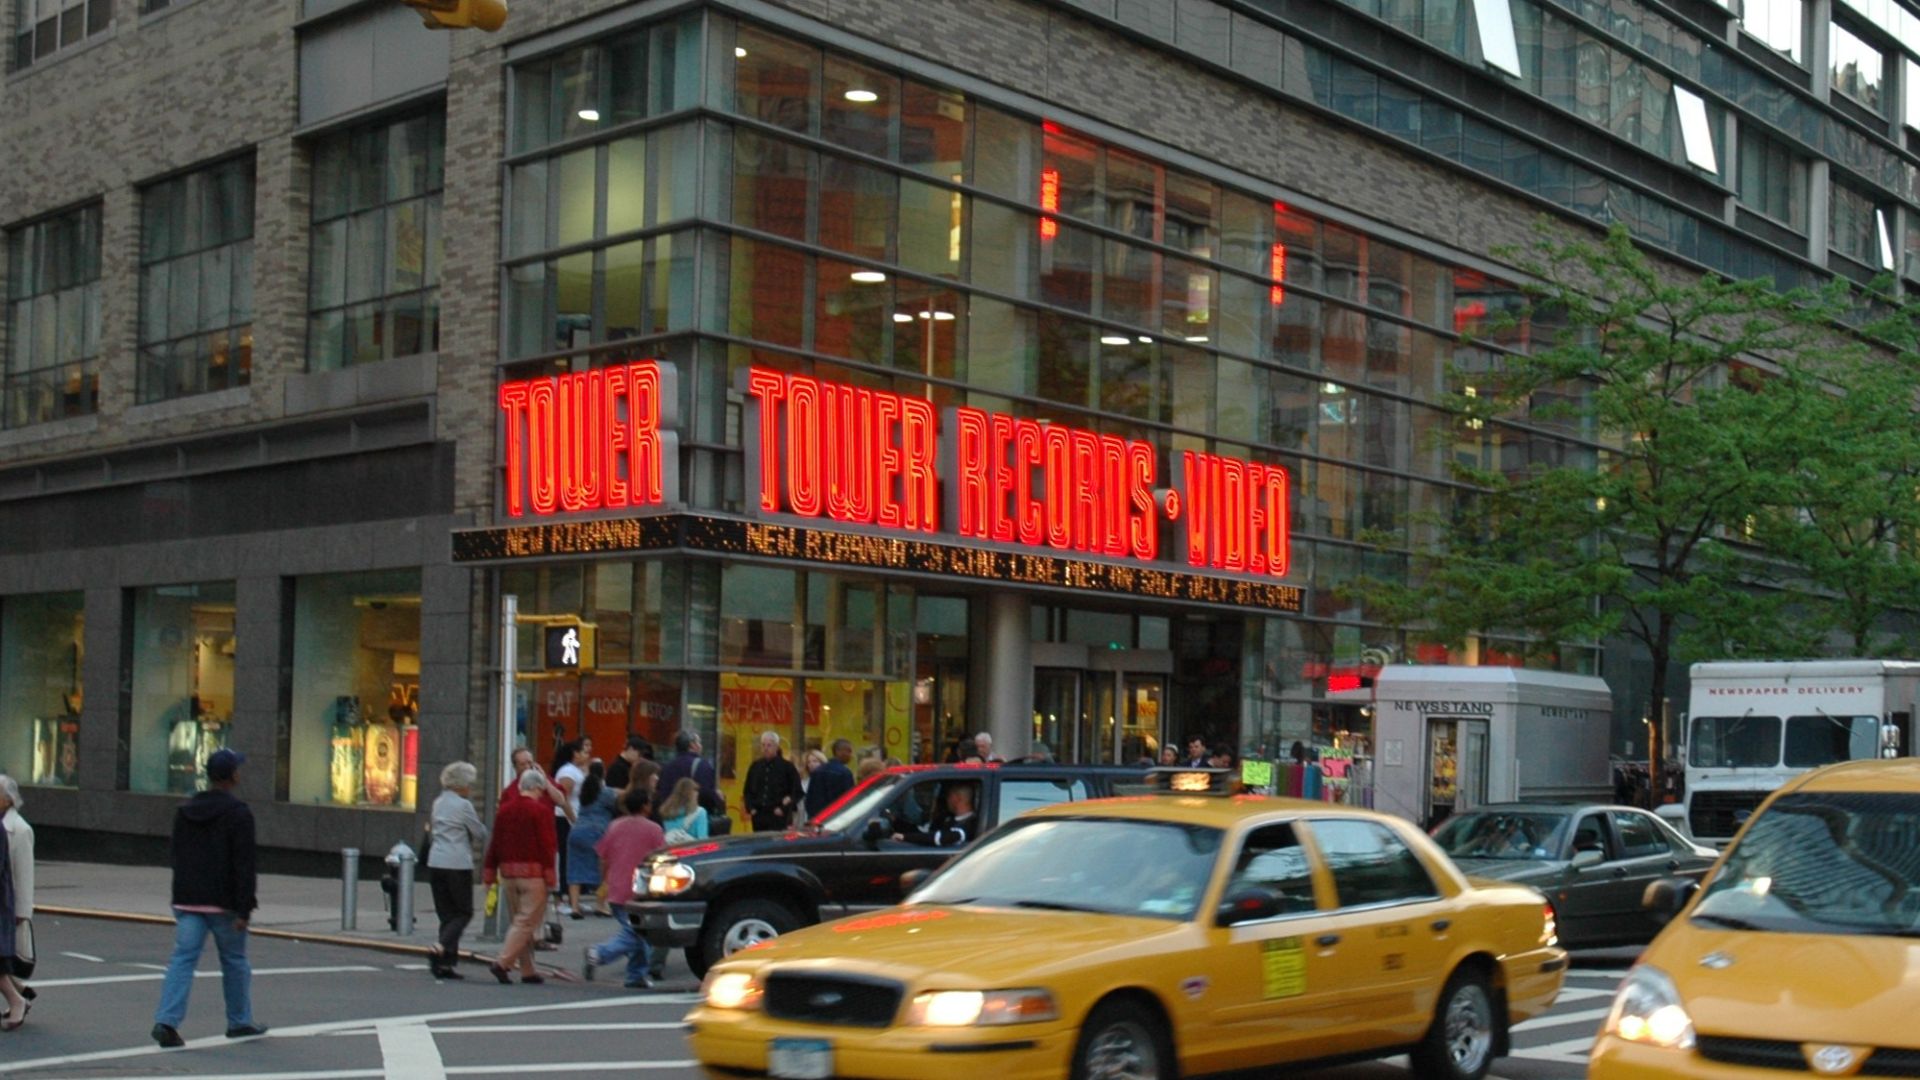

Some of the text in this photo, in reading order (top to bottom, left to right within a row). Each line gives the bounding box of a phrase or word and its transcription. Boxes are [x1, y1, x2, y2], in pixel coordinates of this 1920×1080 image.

[501, 359, 663, 517] TOWER
[749, 365, 1291, 577] TOWER RECORDS VIDEO
[506, 525, 544, 556] NEW
[746, 522, 796, 555] NEW
[805, 528, 906, 567] RIHANNA
[1798, 686, 1865, 694] DELIVERY
[547, 691, 574, 717] EAT
[596, 697, 625, 714] LOOK
[647, 702, 673, 720] STOP
[1395, 701, 1494, 713] NEWSSTAND
